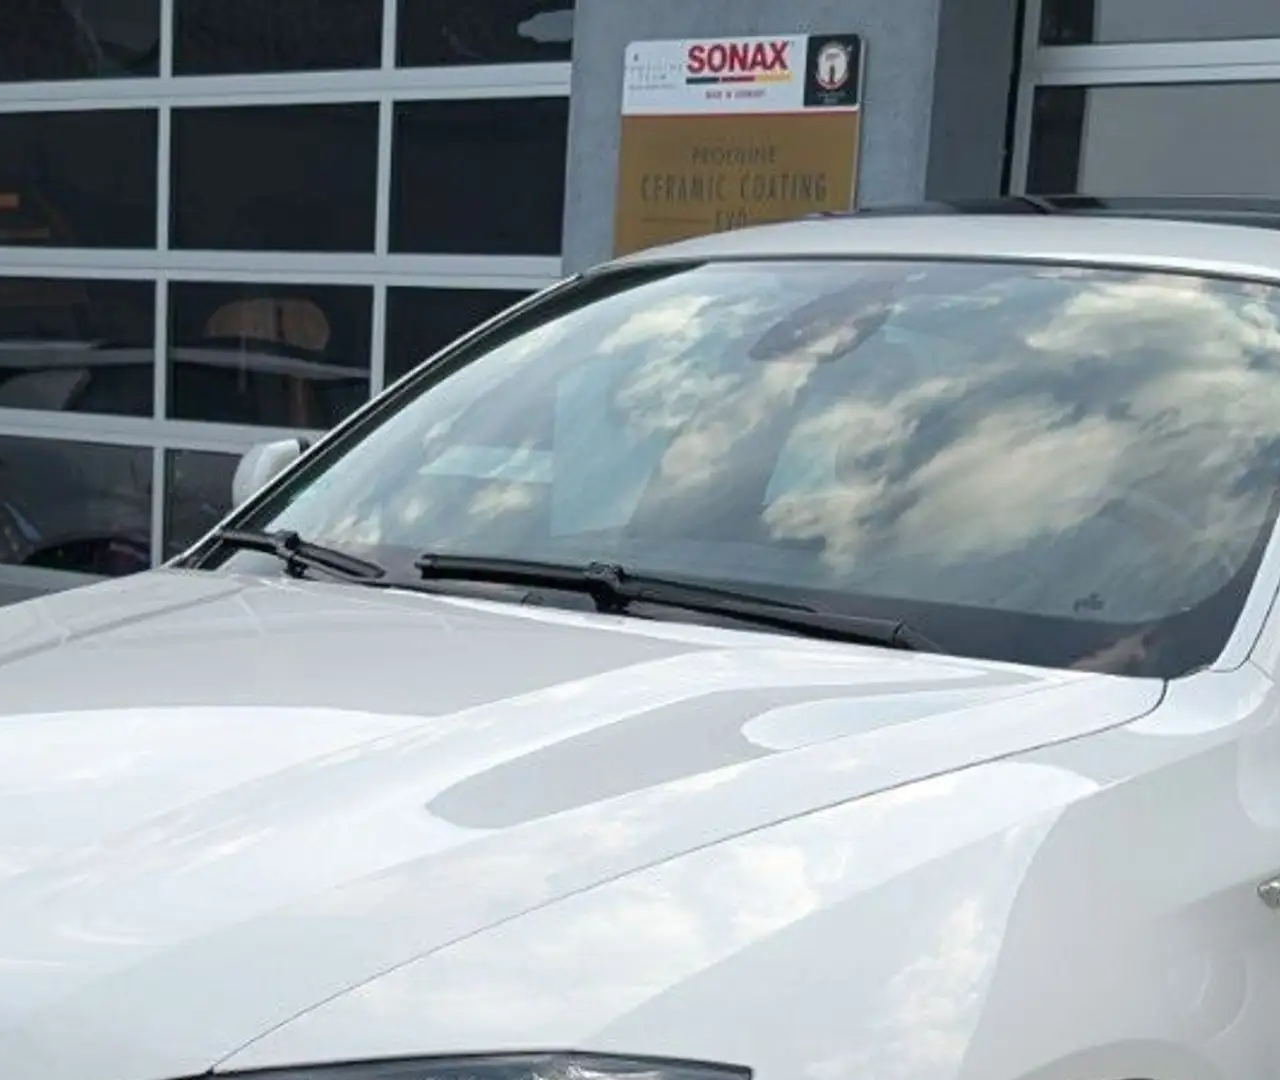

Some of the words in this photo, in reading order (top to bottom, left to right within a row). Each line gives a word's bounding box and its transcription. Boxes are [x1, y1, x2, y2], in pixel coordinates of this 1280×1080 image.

[685, 41, 789, 74] SONAX
[640, 173, 726, 202] CERAMIC
[740, 172, 827, 202] COATING
